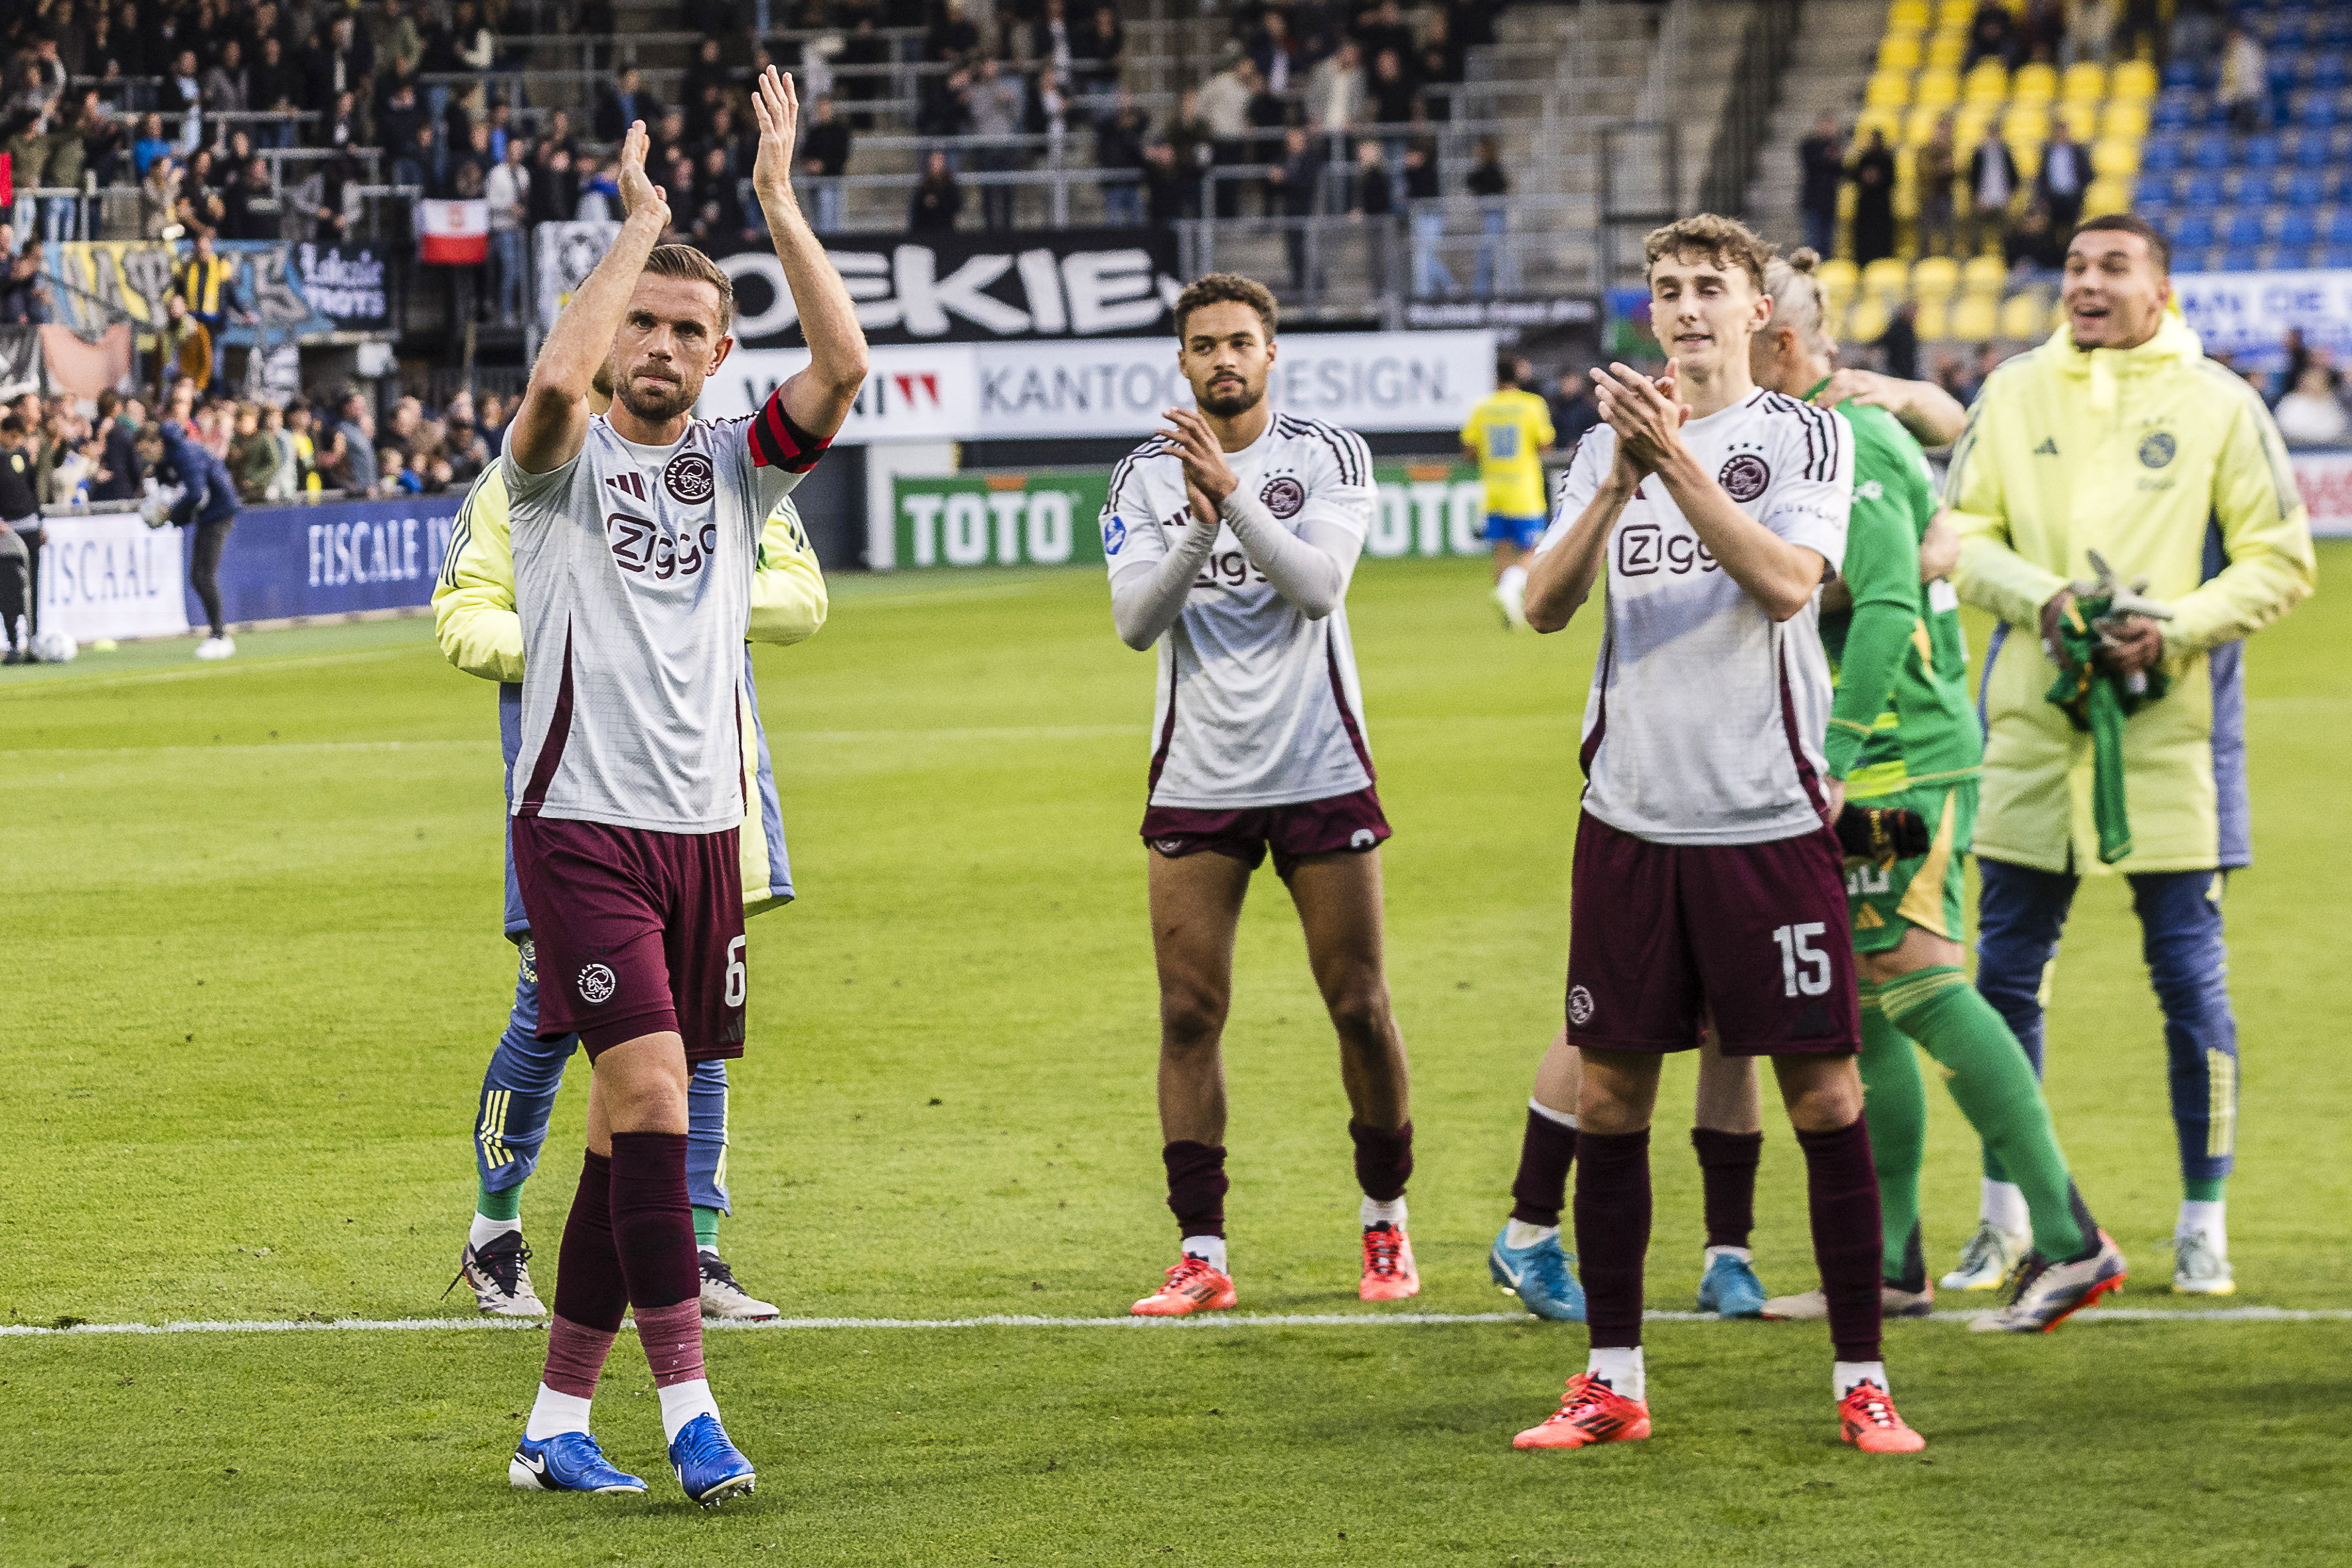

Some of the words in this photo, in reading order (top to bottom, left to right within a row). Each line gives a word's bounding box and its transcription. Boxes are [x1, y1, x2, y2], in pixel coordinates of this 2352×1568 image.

[307, 518, 422, 587] FISCALE
[902, 491, 1074, 566] TOTO
[1369, 482, 1488, 556] OTO
[1628, 534, 1719, 575] Zigg
[48, 536, 157, 605] ISCAAL
[725, 934, 746, 1007] 6
[1772, 921, 1832, 997] 15
